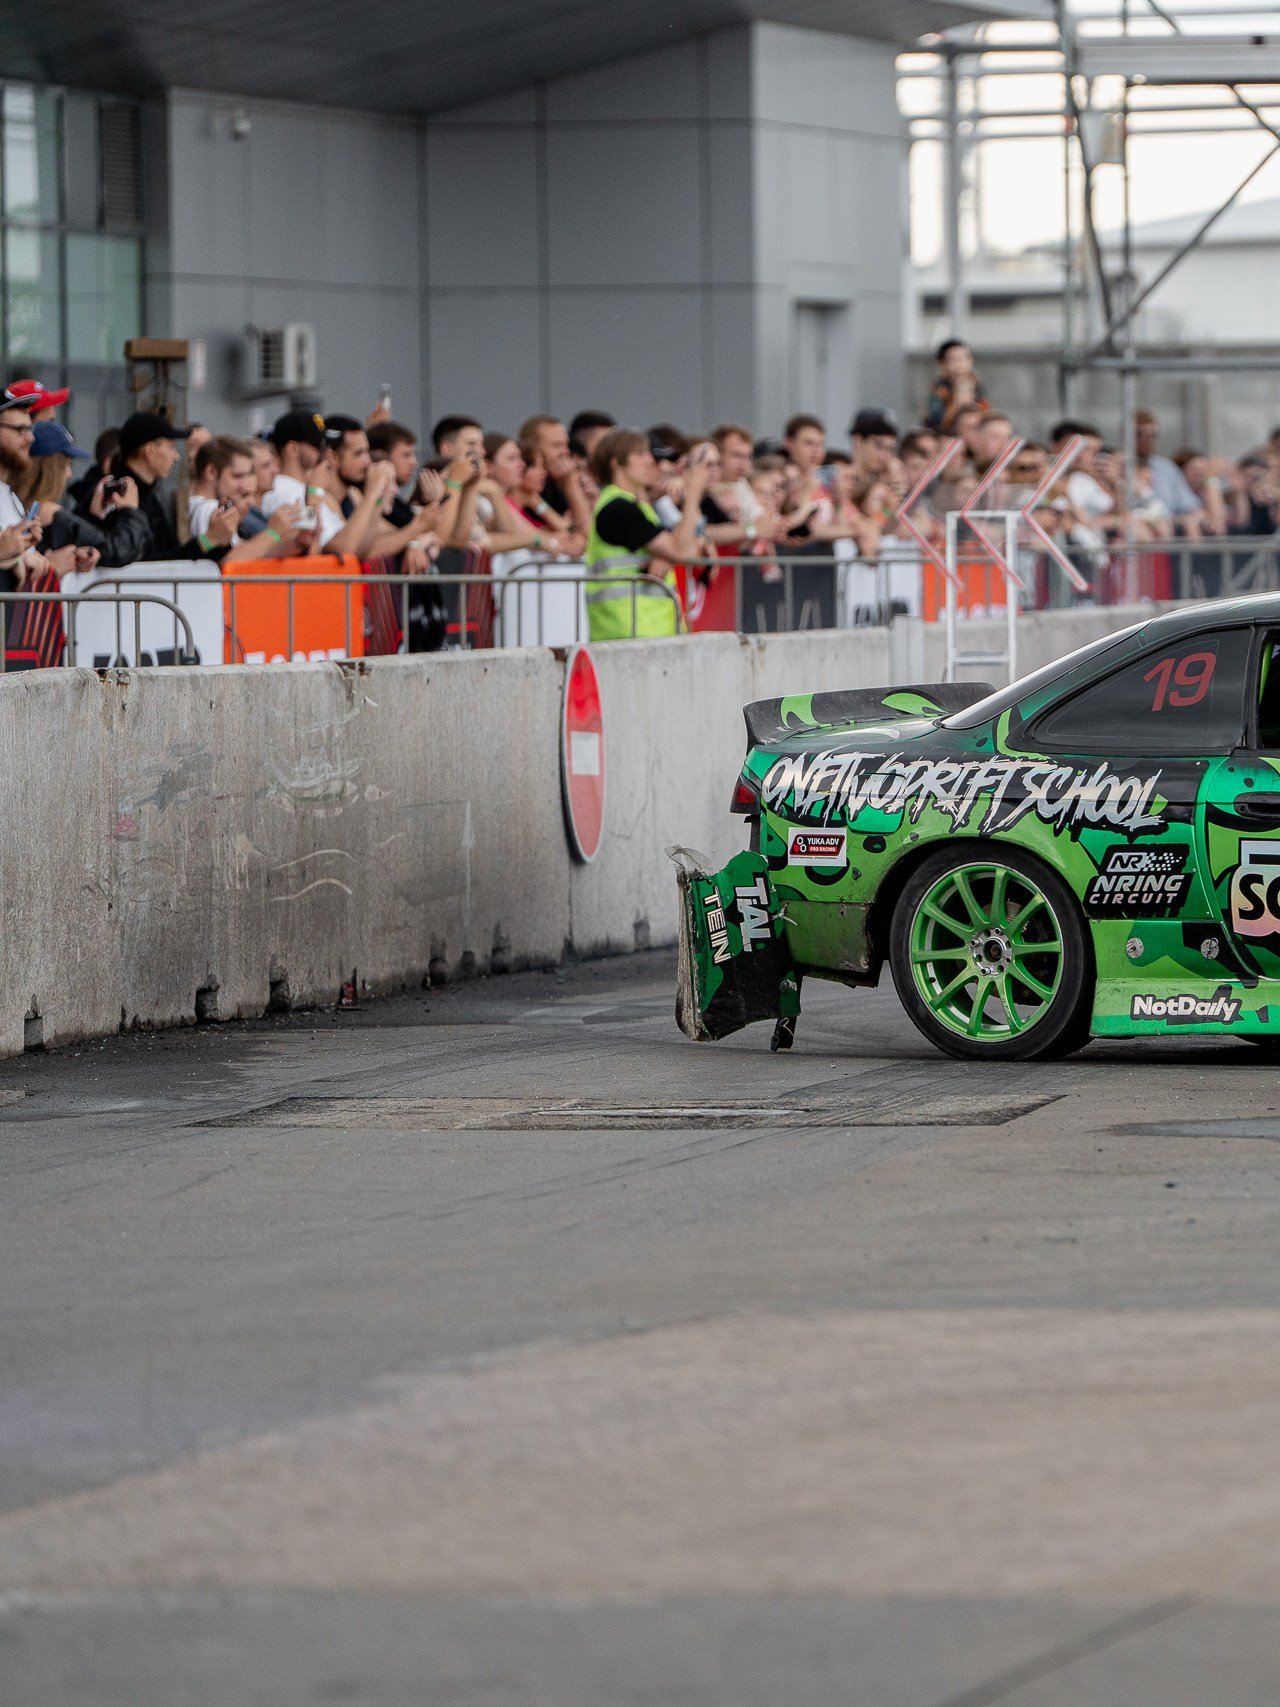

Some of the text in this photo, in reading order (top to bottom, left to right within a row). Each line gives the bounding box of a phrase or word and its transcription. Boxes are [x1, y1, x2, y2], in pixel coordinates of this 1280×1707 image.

[1143, 652, 1217, 712] 19
[1093, 875, 1185, 892] NRING
[1089, 893, 1178, 904] CIRCUIT
[704, 885, 732, 964] TEIN
[1133, 996, 1238, 1022] NotDaily
